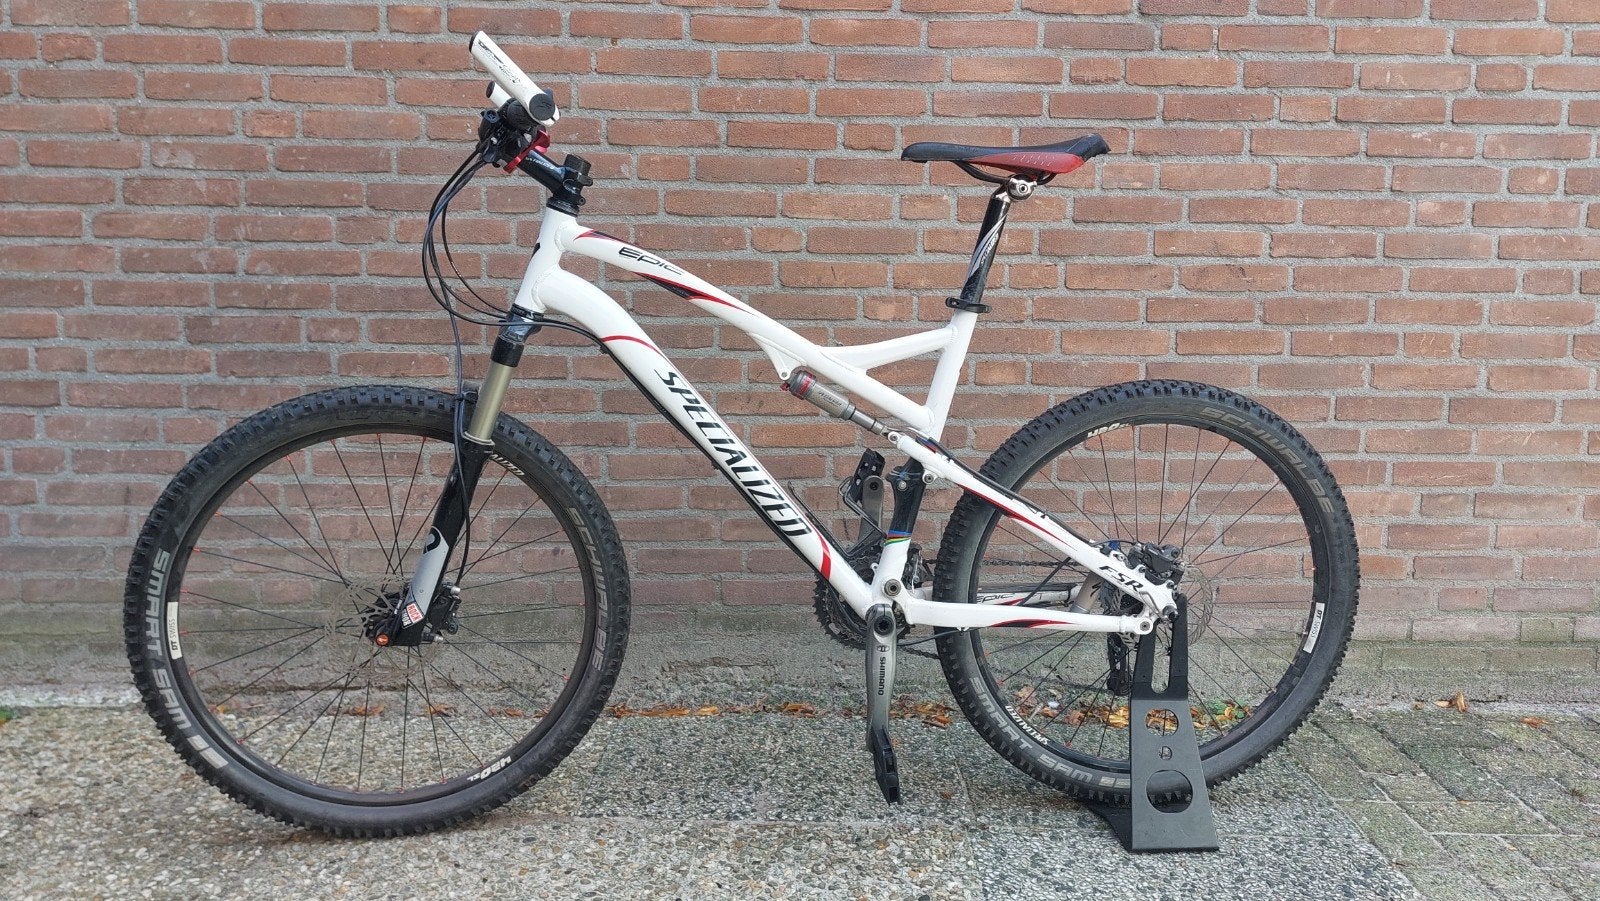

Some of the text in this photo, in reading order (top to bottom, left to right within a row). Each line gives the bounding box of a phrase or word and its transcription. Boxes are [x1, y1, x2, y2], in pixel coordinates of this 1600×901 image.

[653, 368, 812, 537] SPECIALIZED
[1202, 406, 1335, 513] SCHWALBE
[566, 507, 608, 671] SCHWALBE
[1099, 565, 1144, 592] FSR
[145, 548, 192, 730] SMART SAM
[171, 640, 179, 651] DT
[877, 656, 887, 696] SHIMANO
[969, 677, 1094, 783] SMART SAM
[1005, 705, 1051, 746] SPECIALIZED
